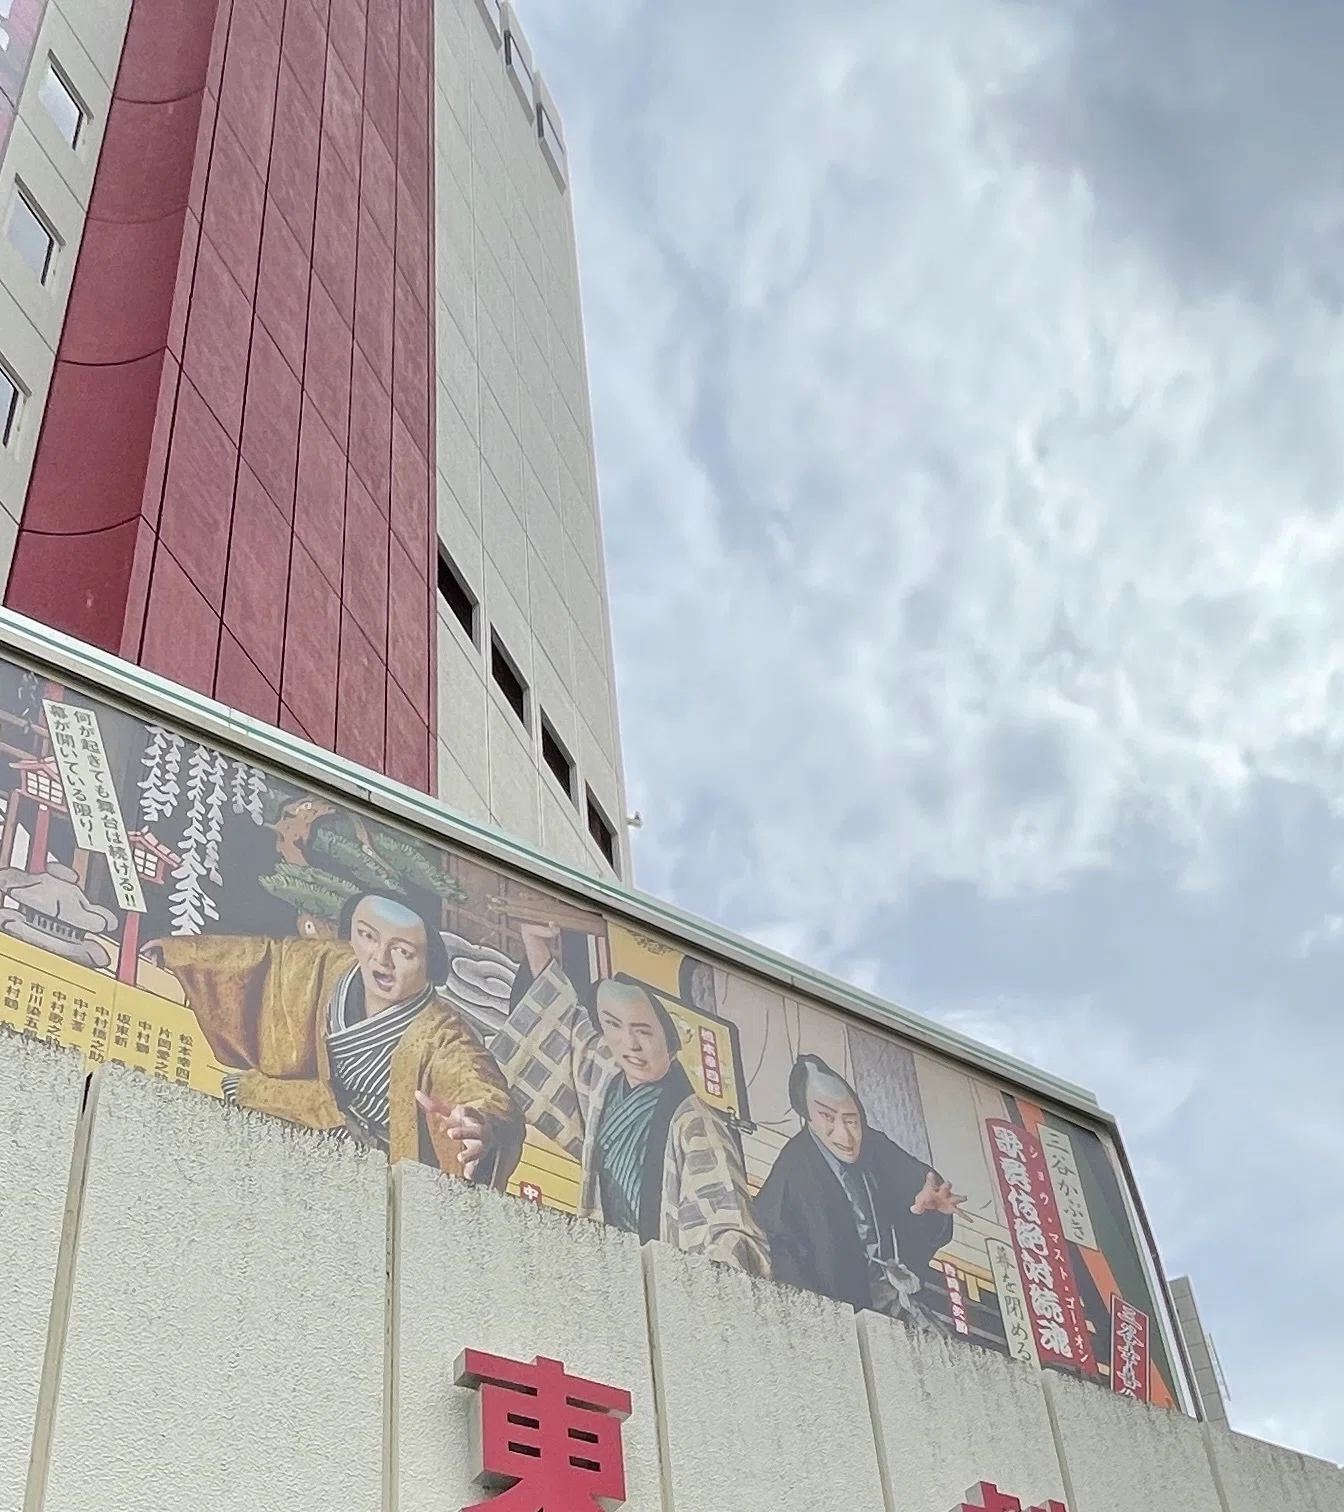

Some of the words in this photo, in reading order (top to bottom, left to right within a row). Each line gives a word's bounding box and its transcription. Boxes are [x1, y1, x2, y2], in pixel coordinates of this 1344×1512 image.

[995, 1243, 1033, 1370] 幕を閉める
